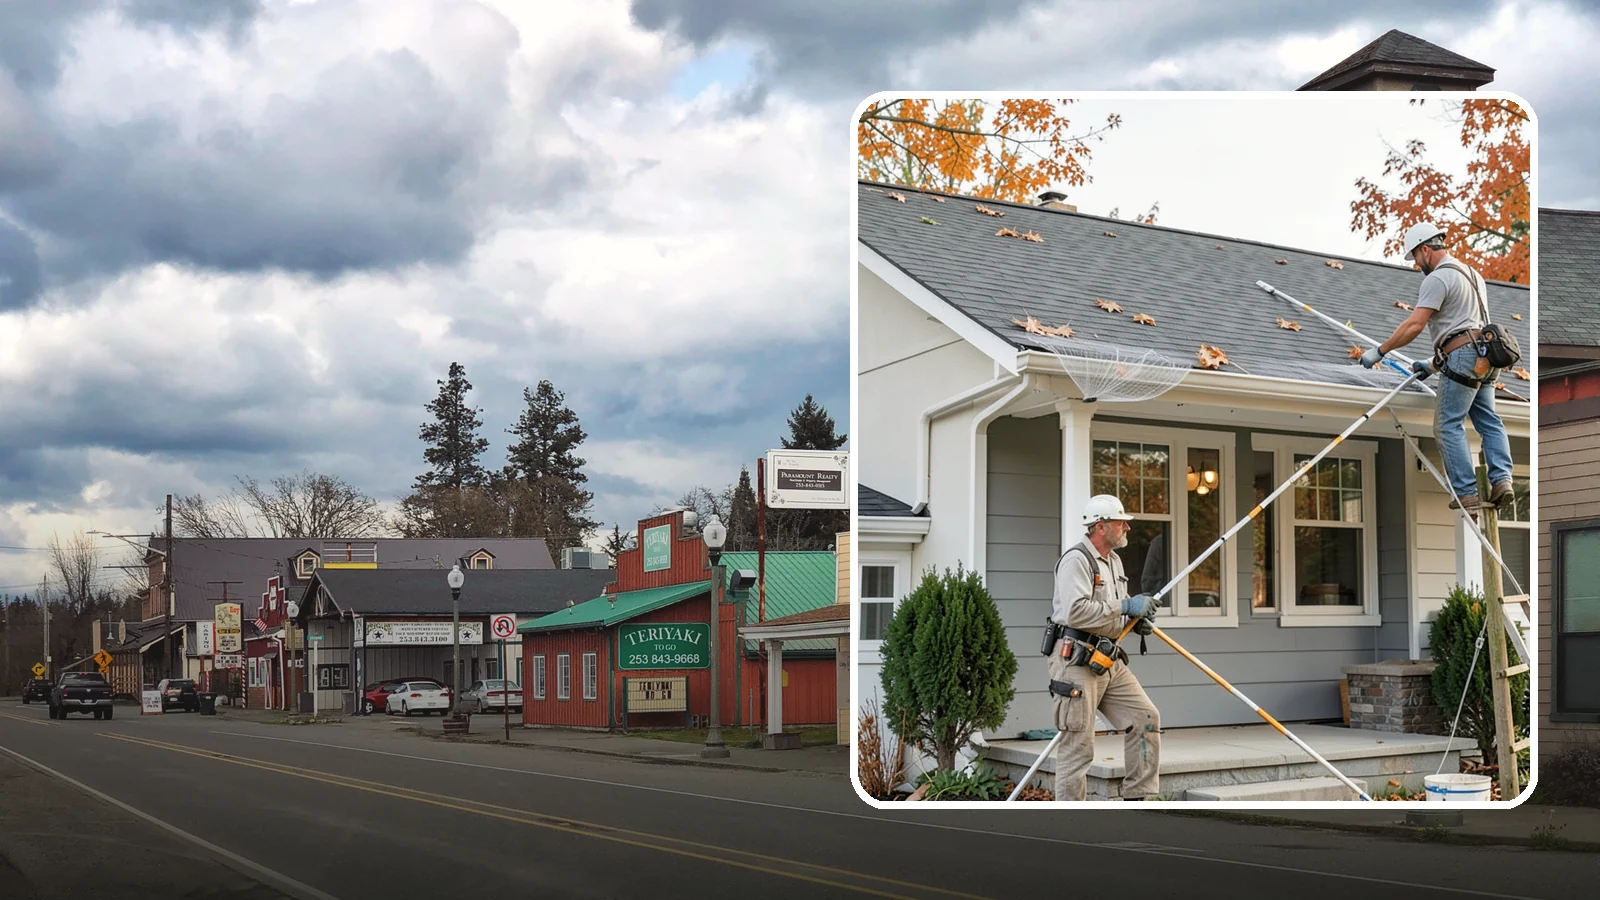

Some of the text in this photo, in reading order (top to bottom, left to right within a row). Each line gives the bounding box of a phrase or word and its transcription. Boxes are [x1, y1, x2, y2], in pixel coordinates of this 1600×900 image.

[781, 471, 815, 479] PARAMOUNT
[624, 627, 702, 646] TERIYAKI
[628, 654, 700, 665] 253 843-9668
[639, 681, 672, 690] TERIYAKI
